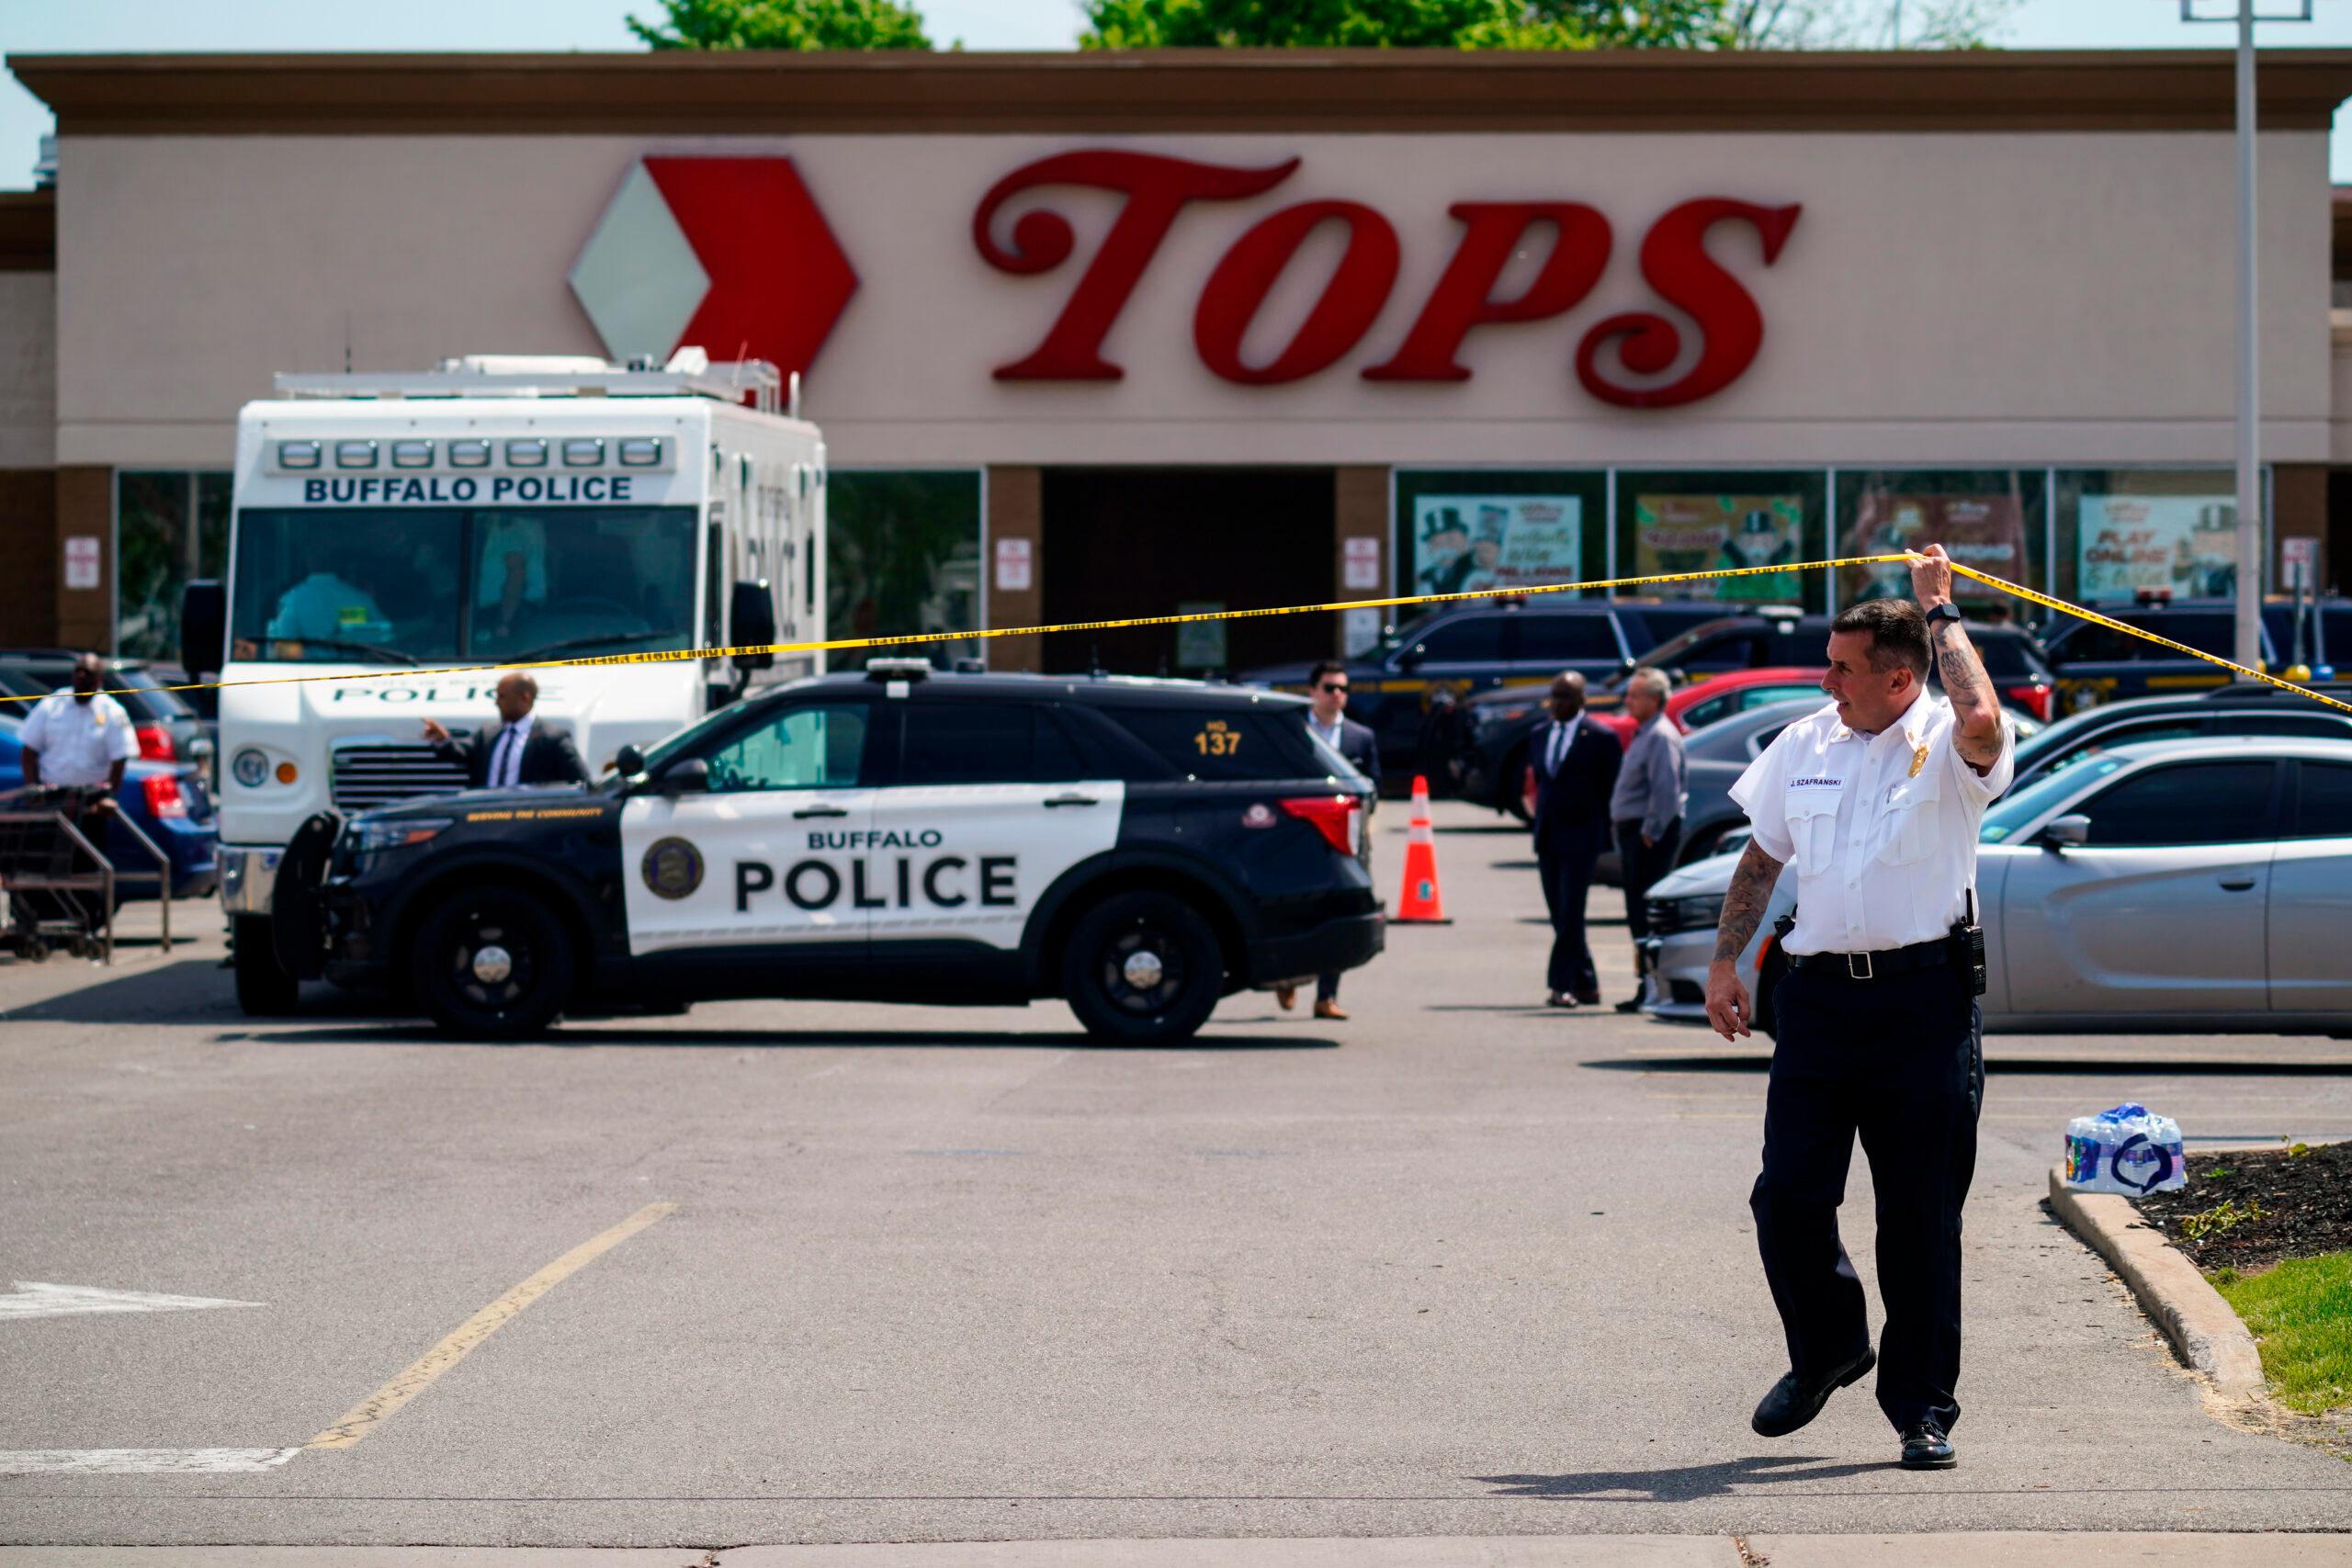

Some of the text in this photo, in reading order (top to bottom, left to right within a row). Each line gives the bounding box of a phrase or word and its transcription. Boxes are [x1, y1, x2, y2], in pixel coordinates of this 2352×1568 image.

[304, 477, 633, 502] BUFFALO POLICE
[1194, 732, 1241, 755] 137
[1796, 778, 1842, 786] SZAFRANSKI
[808, 829, 943, 850] BUFFALO
[736, 855, 1017, 912] POLICE
